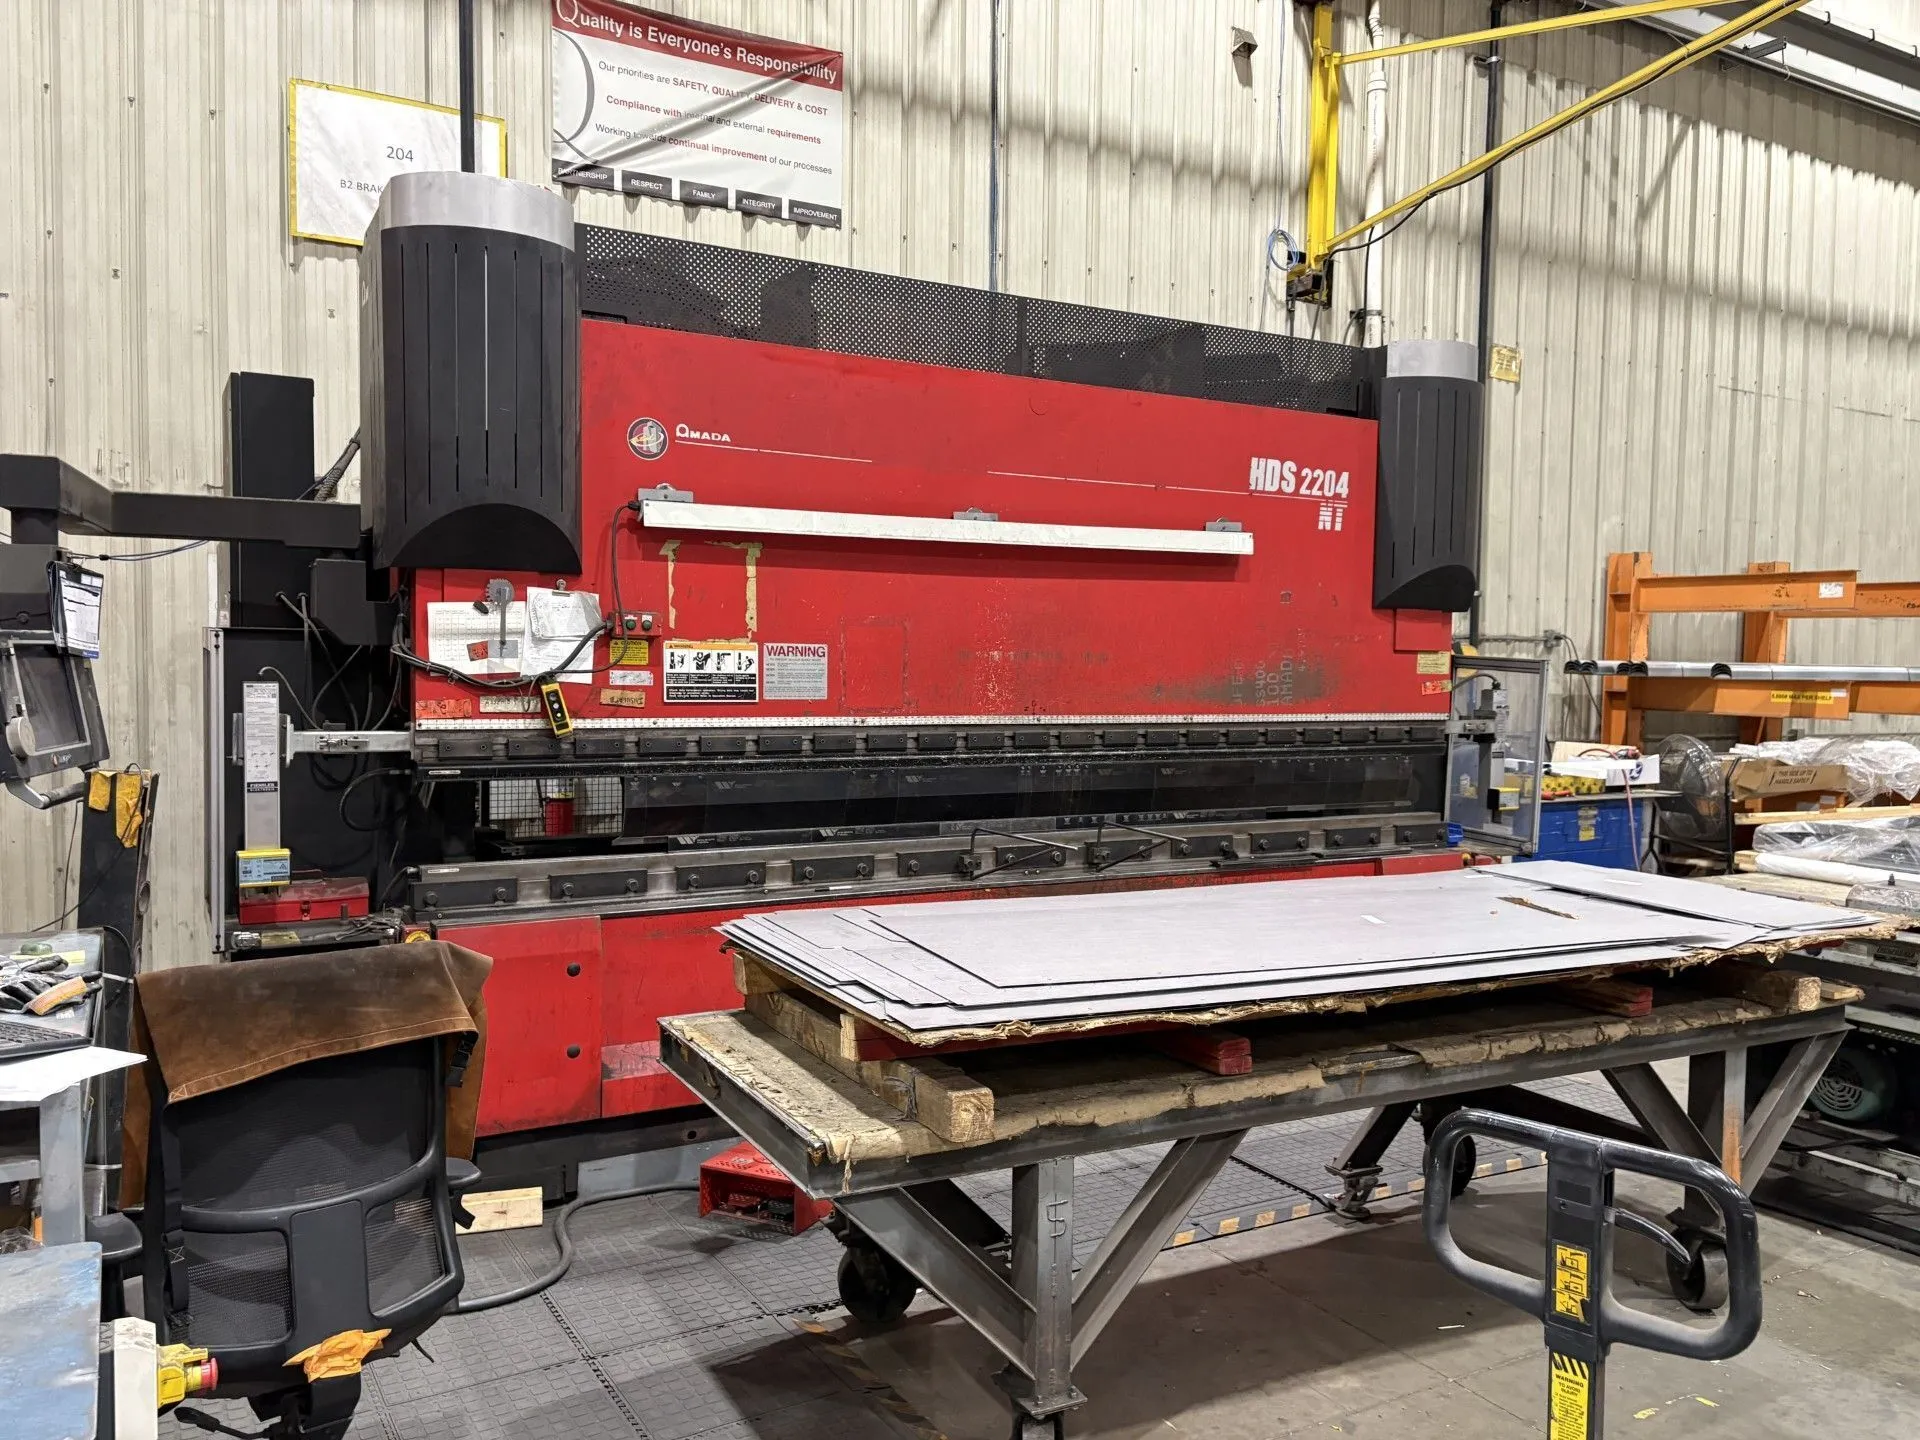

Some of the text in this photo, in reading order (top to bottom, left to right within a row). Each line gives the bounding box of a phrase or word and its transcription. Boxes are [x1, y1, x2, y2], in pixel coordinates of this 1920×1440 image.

[556, 0, 624, 38] Quality
[629, 22, 643, 39] is
[736, 46, 837, 84] Responsibility
[598, 60, 616, 71] Our
[617, 65, 655, 81] priorities
[656, 75, 671, 84] are
[672, 77, 710, 94] SAFETY,
[754, 92, 796, 110] DELIVERY
[797, 102, 803, 111] &
[805, 103, 828, 116] COST
[606, 95, 661, 115] Compliance
[663, 107, 682, 119] with
[716, 116, 731, 127] and
[733, 121, 765, 133] external
[767, 128, 822, 145] requirements
[386, 146, 414, 162] 204
[595, 123, 833, 175] Working towards continual improvement of our processes
[340, 179, 384, 194] B2 BRAK
[631, 179, 664, 190] RESPECT
[692, 190, 716, 199] FAMILY
[742, 198, 776, 209] INTEGRITY
[793, 207, 838, 220] IMPROVEMENT
[1249, 457, 1349, 498] HDS 2204
[1318, 502, 1348, 531] NT
[766, 645, 826, 658] WARNING
[1555, 1374, 1584, 1388] WARNING
